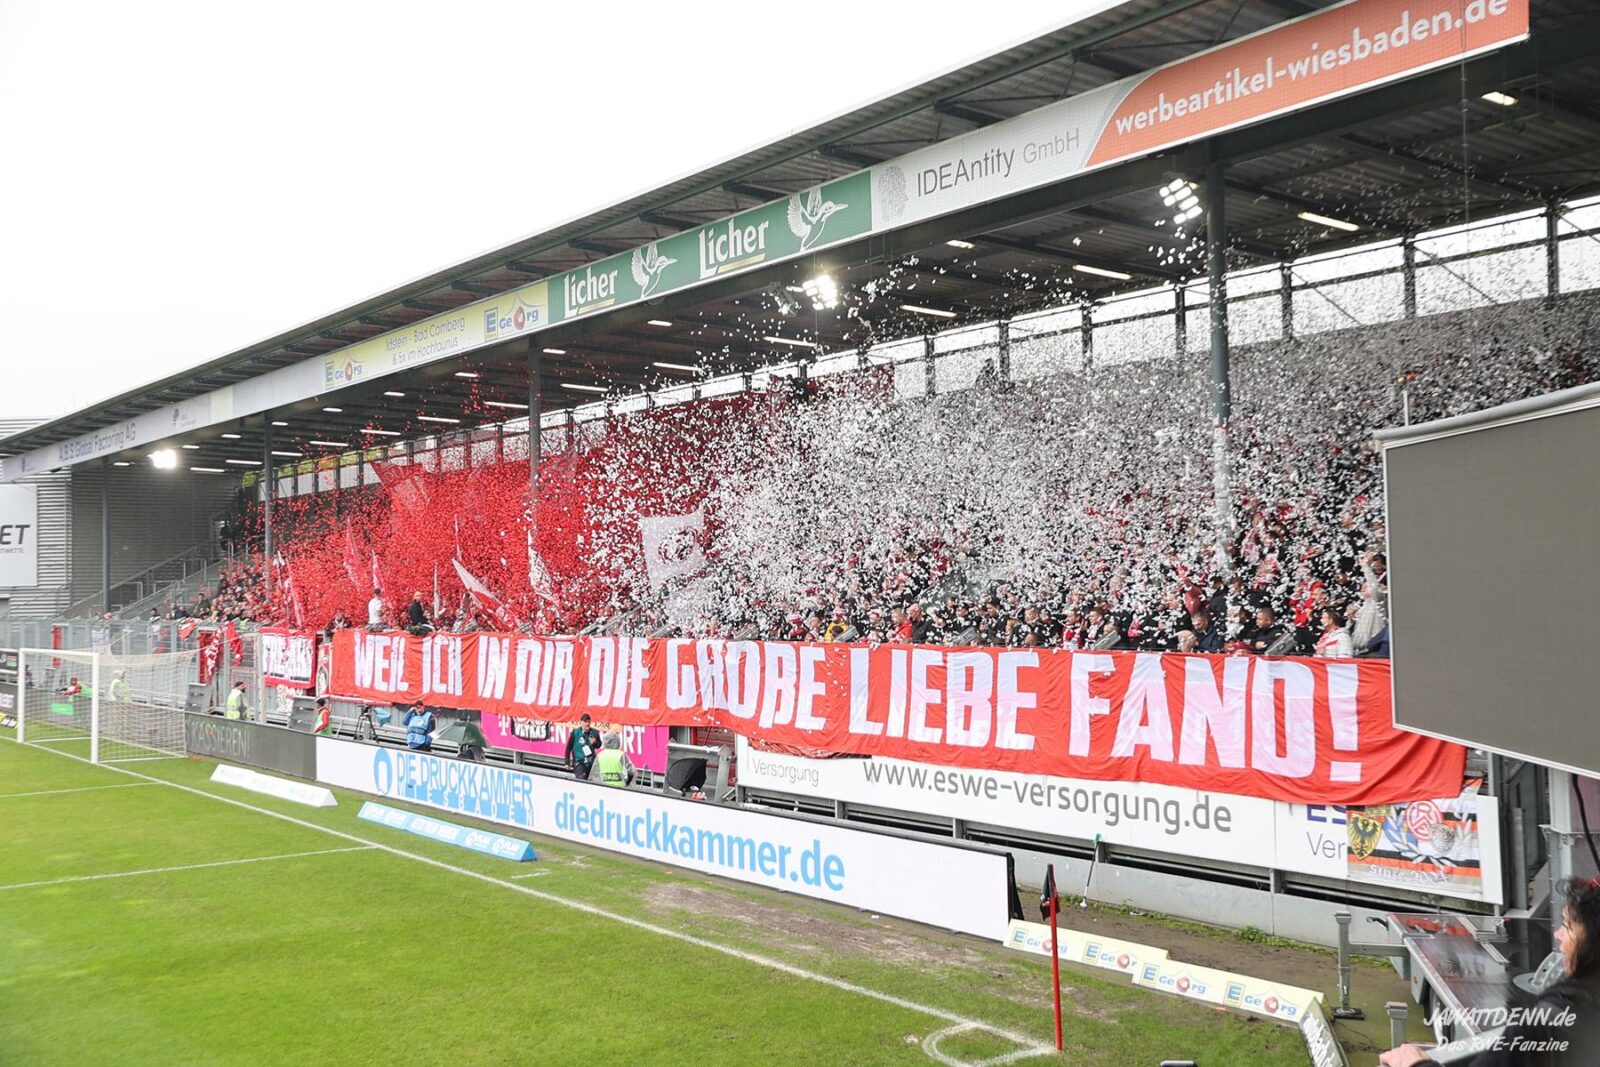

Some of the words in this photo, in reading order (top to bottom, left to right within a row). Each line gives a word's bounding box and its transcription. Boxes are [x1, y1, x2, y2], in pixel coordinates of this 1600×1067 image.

[1115, 0, 1508, 135] werbeartikel-wiesbaden.de
[918, 148, 1015, 197] IDEAntity
[1023, 128, 1080, 164] GmbH
[699, 219, 769, 280] Licher
[564, 267, 618, 317] Licher
[354, 631, 409, 693] WEIL
[422, 635, 463, 696] ICH
[477, 635, 510, 699] IN
[514, 639, 574, 707] DIR
[587, 637, 651, 710] DIE
[848, 648, 1041, 750] LIEBE
[396, 752, 417, 784] DIE
[421, 756, 533, 809] DRUCKKAMMER
[753, 757, 819, 787] Versorgung
[863, 761, 1233, 834] www.eswe-versorgung.de
[555, 792, 845, 891] diedruckkammer.de
